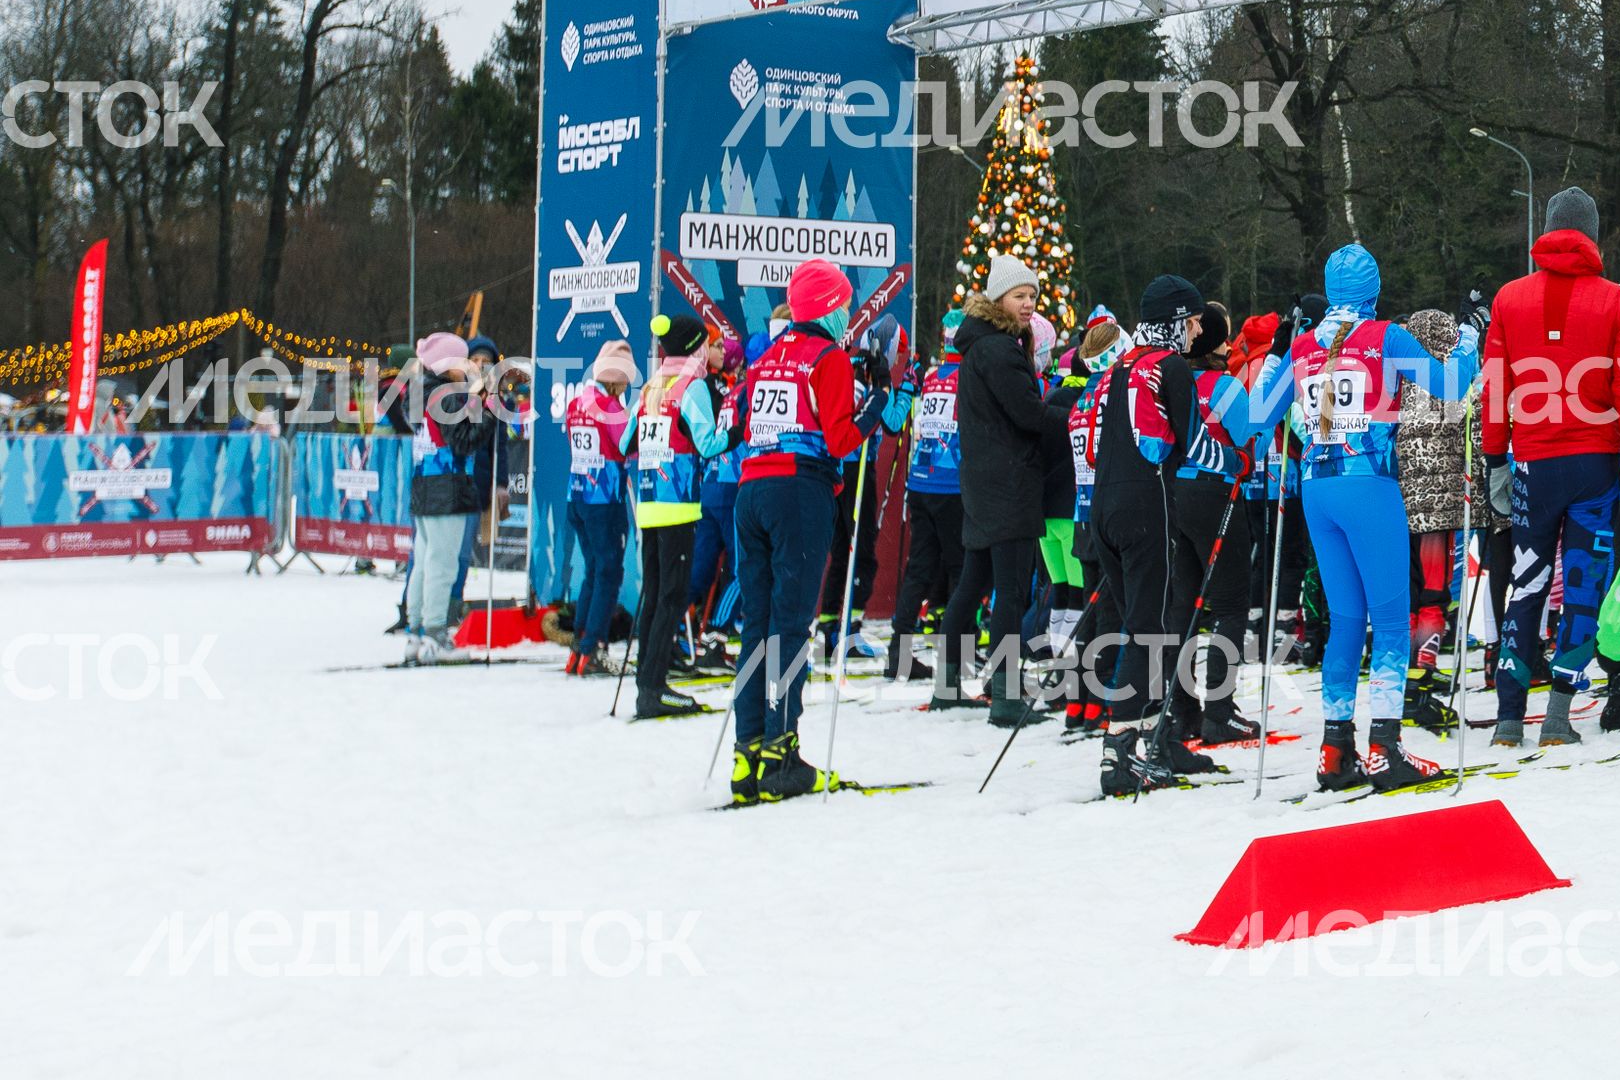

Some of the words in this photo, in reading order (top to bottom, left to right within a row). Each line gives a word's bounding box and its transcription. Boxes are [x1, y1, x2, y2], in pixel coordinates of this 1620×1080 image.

[786, 4, 824, 17] ДСКОГО
[825, 7, 860, 21] ОКРУГА
[583, 15, 635, 36] ОДИНЦОВСКИЙ
[583, 34, 602, 50] ПАРК
[602, 31, 638, 48] КУЛЬТУРЫ,
[583, 48, 609, 65] СПОРТА
[609, 48, 616, 61] И
[615, 44, 643, 61] ОТДЫХА
[765, 67, 842, 86] ОДИНЦОВСКИЙ
[765, 81, 793, 96] ПАРК
[793, 83, 847, 101] КУЛЬТУРЫ,
[765, 96, 803, 110] СПОРТА
[804, 98, 814, 112] И
[814, 99, 856, 115] ОТДЫХА
[557, 116, 641, 151] МОСОБЛ
[557, 143, 623, 174] СПОРТ
[688, 221, 889, 258] МАНЖОСОВСКАЯ
[552, 265, 637, 293] МАНЖОСОВСКАЯ
[752, 388, 788, 416] 975
[922, 397, 949, 417] 987
